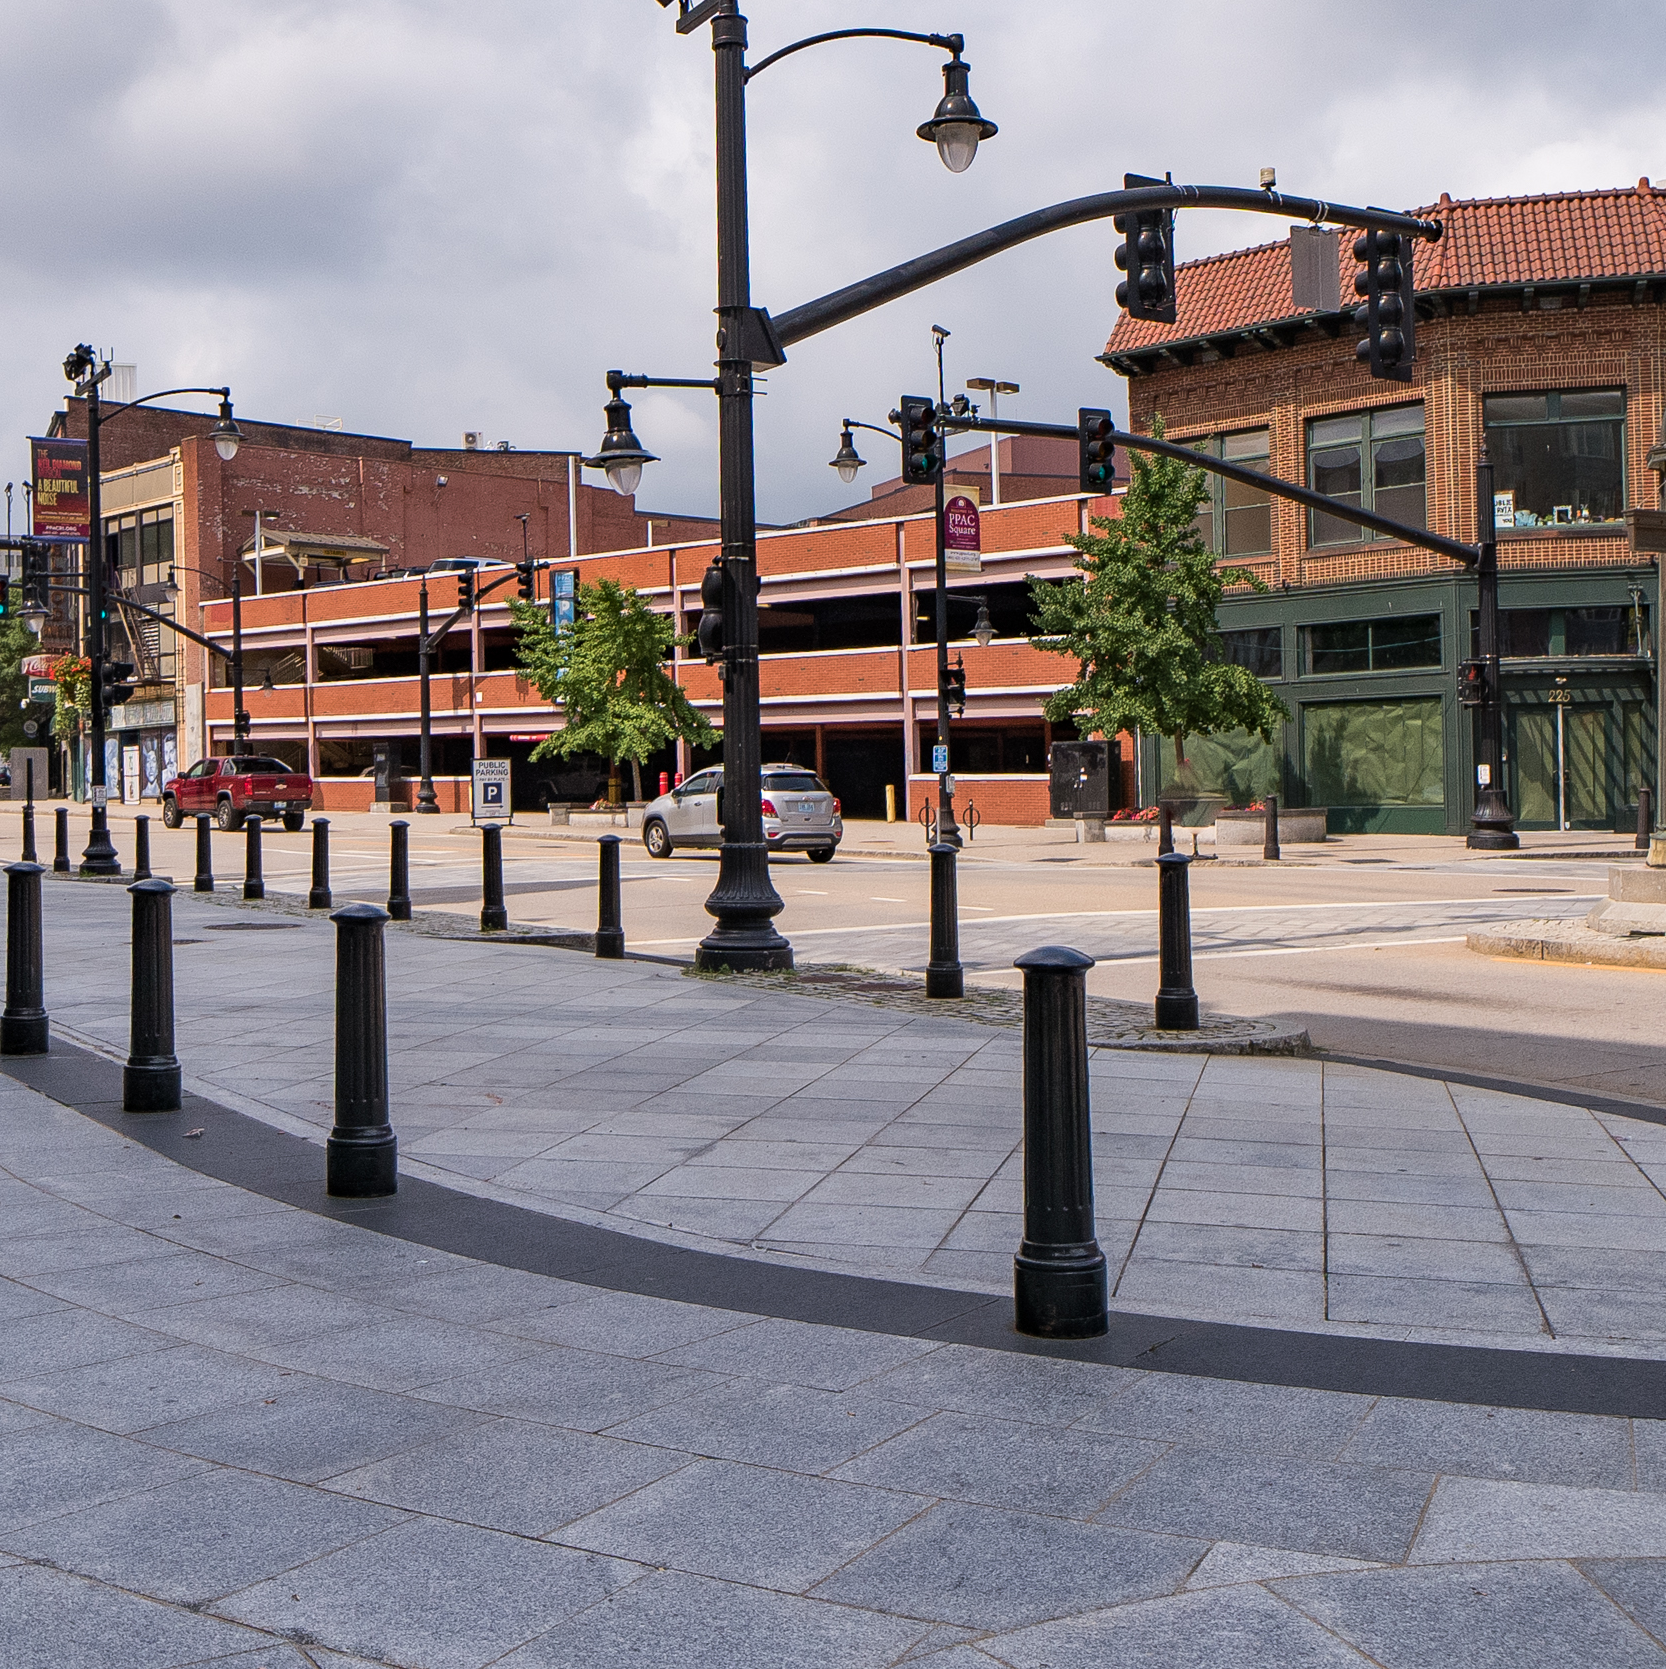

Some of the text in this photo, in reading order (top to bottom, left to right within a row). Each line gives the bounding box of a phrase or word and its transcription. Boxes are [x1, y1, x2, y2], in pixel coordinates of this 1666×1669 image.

[37, 449, 49, 458] THE
[52, 459, 82, 470] DIAMOND
[38, 479, 79, 494] A BEAUTIFUL
[37, 492, 58, 506] NOISE
[949, 513, 976, 526] PPAC
[949, 524, 976, 537] Square
[32, 684, 57, 693] SUBW
[1548, 689, 1571, 702] 225
[478, 761, 506, 769] PUBLIC
[475, 769, 509, 777] PARKING
[487, 786, 498, 801] P
